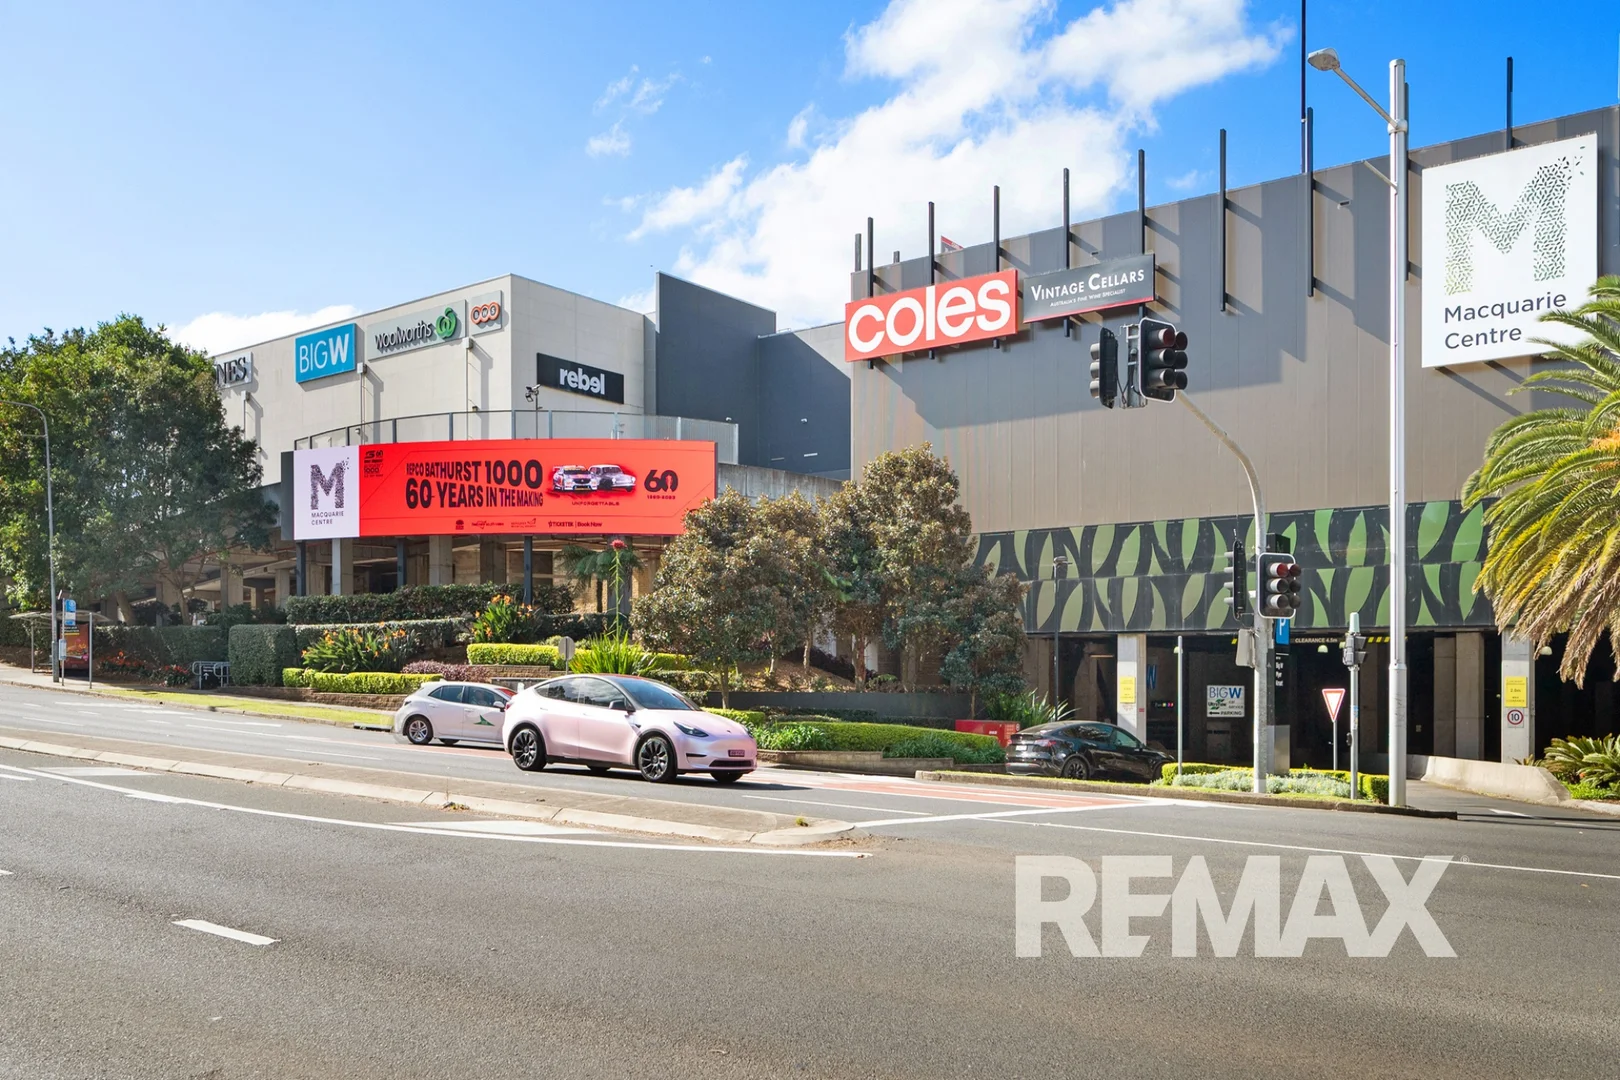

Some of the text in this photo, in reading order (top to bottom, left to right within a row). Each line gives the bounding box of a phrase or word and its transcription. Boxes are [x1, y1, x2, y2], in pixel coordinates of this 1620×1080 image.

[1031, 269, 1145, 301] VINTAGE CELLARS
[849, 279, 1011, 353] coles
[1444, 291, 1567, 324] Macquarie
[375, 320, 433, 350] Woolworths
[1444, 327, 1522, 350] Centre
[559, 367, 605, 395] rebel
[425, 460, 482, 483] BATHURST
[484, 459, 543, 489] 1000
[406, 478, 543, 509] 60 YEARS IN THE MAKING
[1511, 713, 1520, 722] 10
